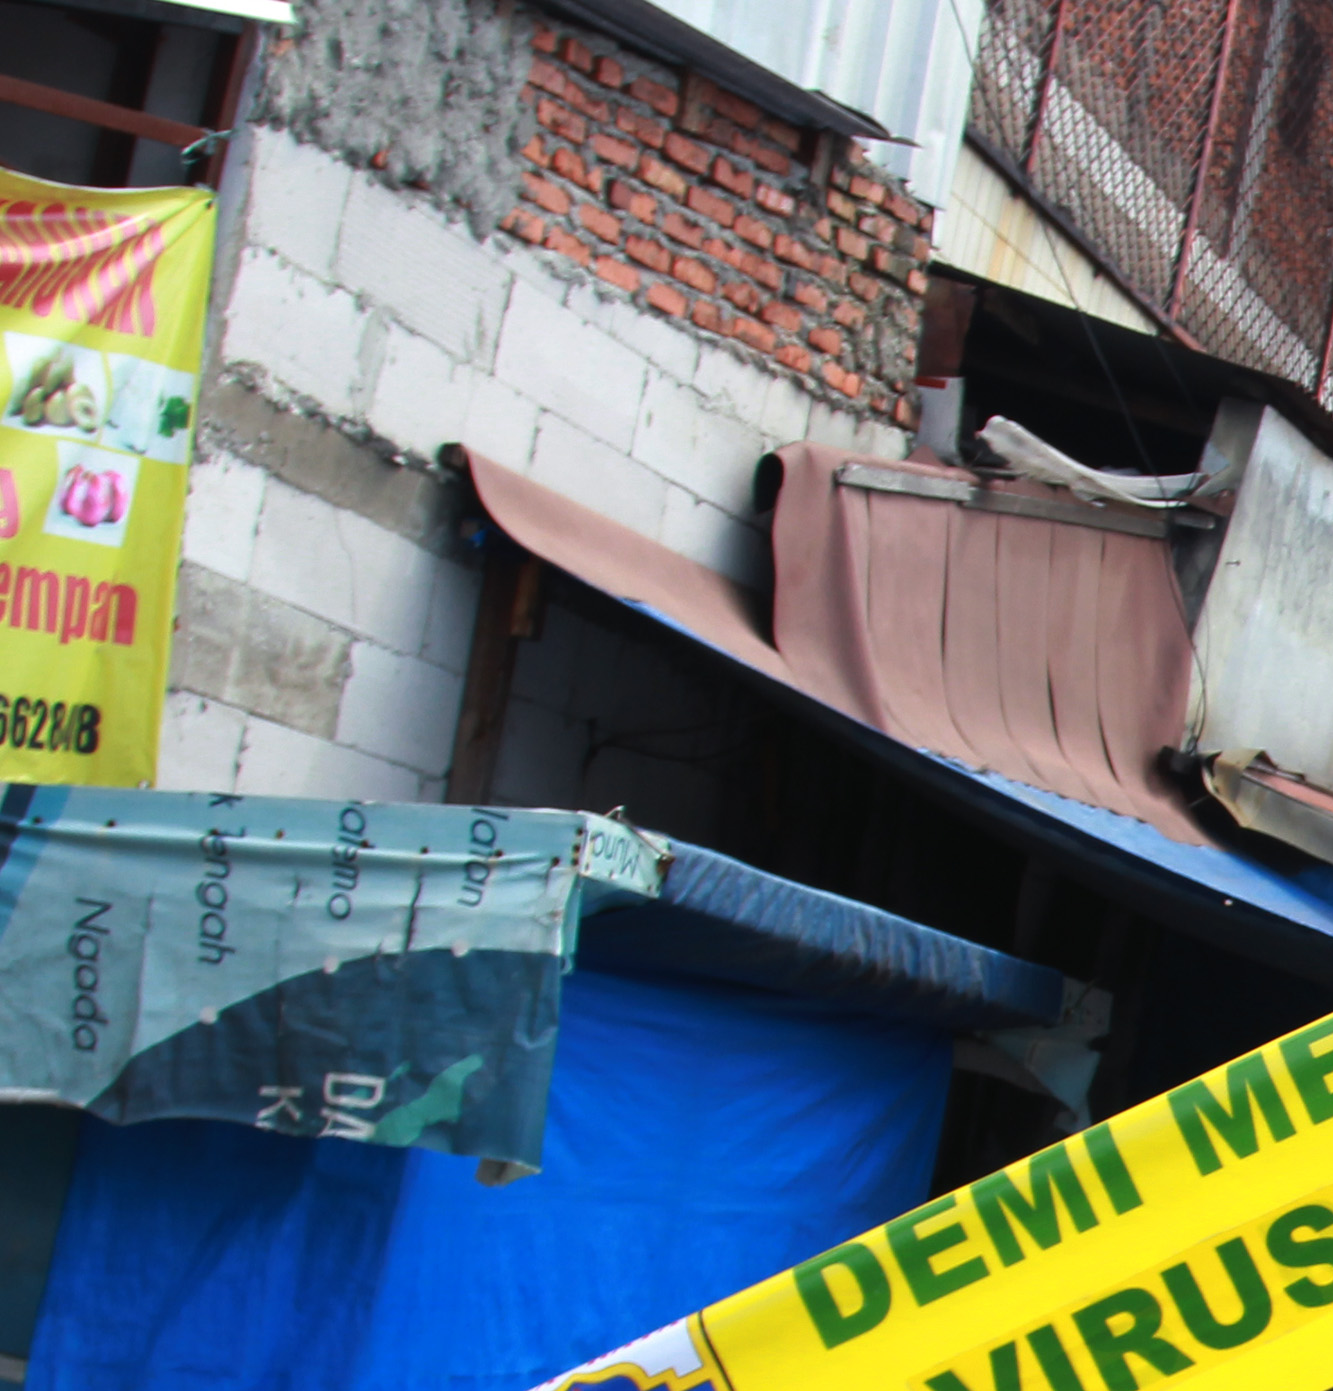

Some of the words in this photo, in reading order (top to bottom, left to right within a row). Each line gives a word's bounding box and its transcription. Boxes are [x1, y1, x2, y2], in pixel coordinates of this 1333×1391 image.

[0, 562, 138, 646] empan
[326, 804, 377, 921] alemo
[67, 896, 114, 1053] Ngada
[793, 1123, 1143, 1350] DEMI
